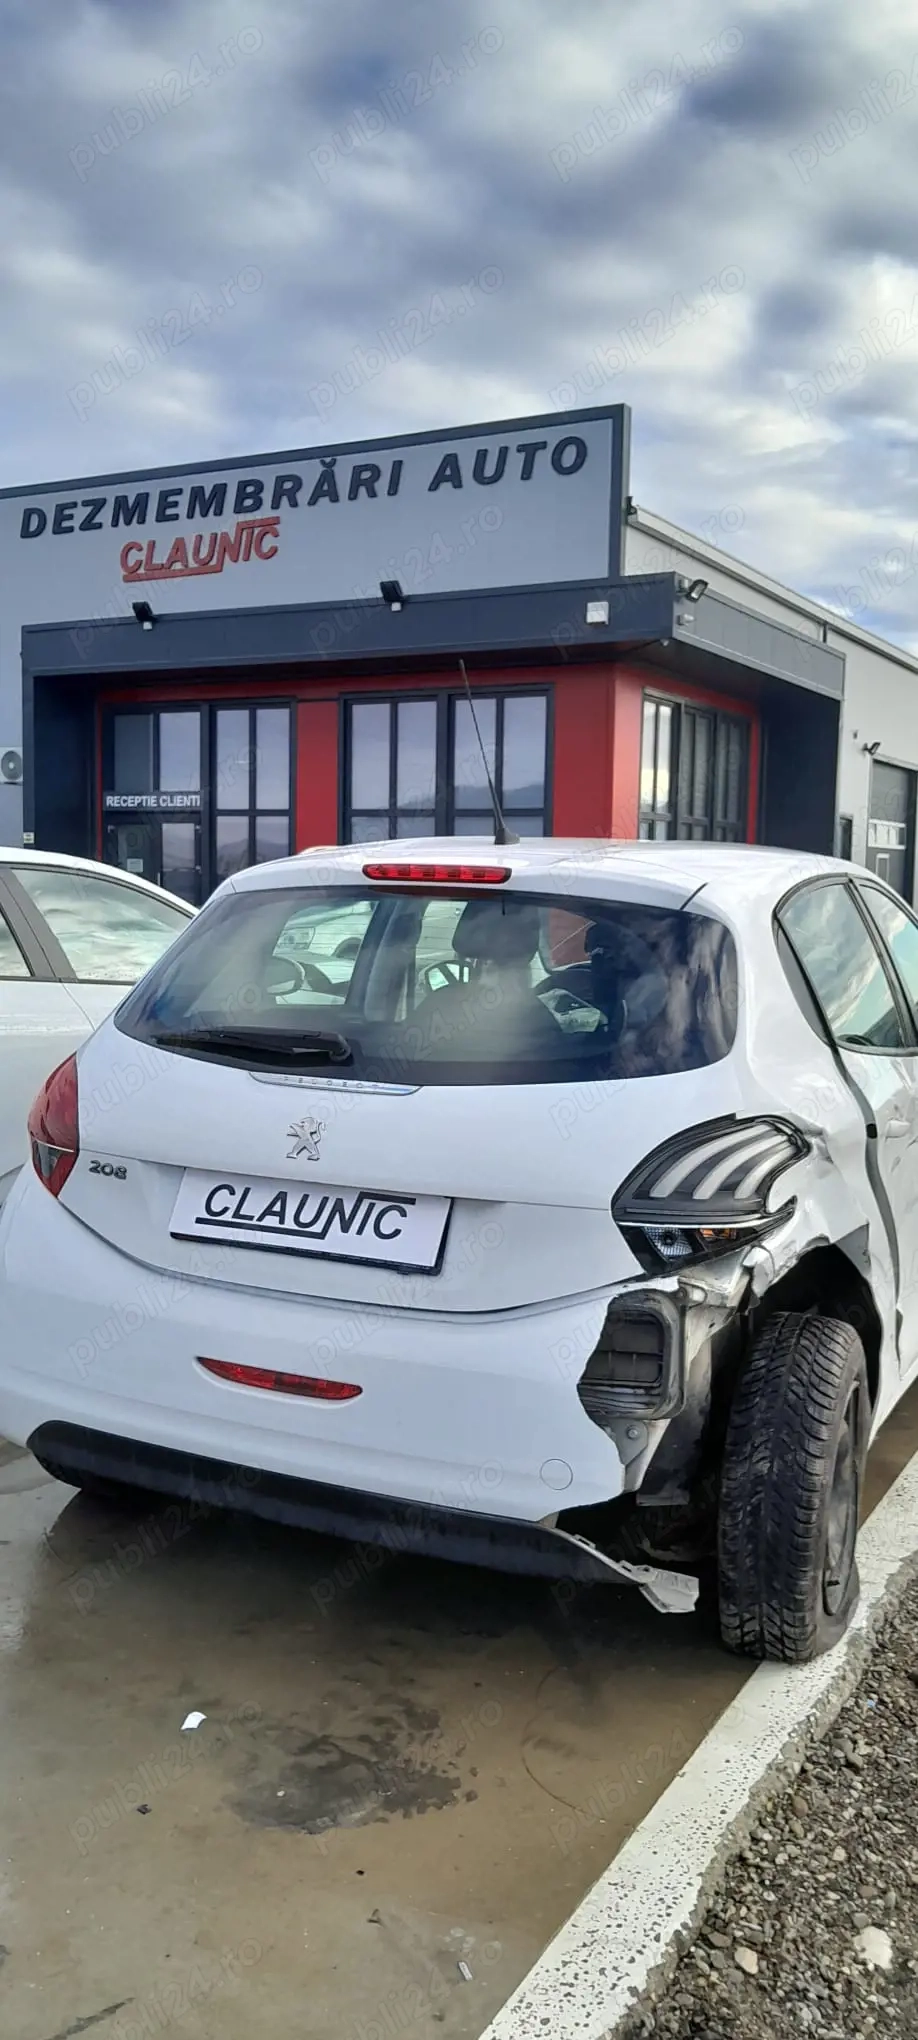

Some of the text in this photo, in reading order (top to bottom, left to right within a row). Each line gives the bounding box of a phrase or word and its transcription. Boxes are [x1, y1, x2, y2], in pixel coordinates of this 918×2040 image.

[20, 436, 588, 539] DEZMEMBRĂRI AUTO
[120, 517, 280, 581] CLAUNIC
[106, 795, 201, 807] RECEPTIE CLIENTI
[88, 1160, 127, 1180] 208
[200, 1184, 412, 1240] CLAUNIC
